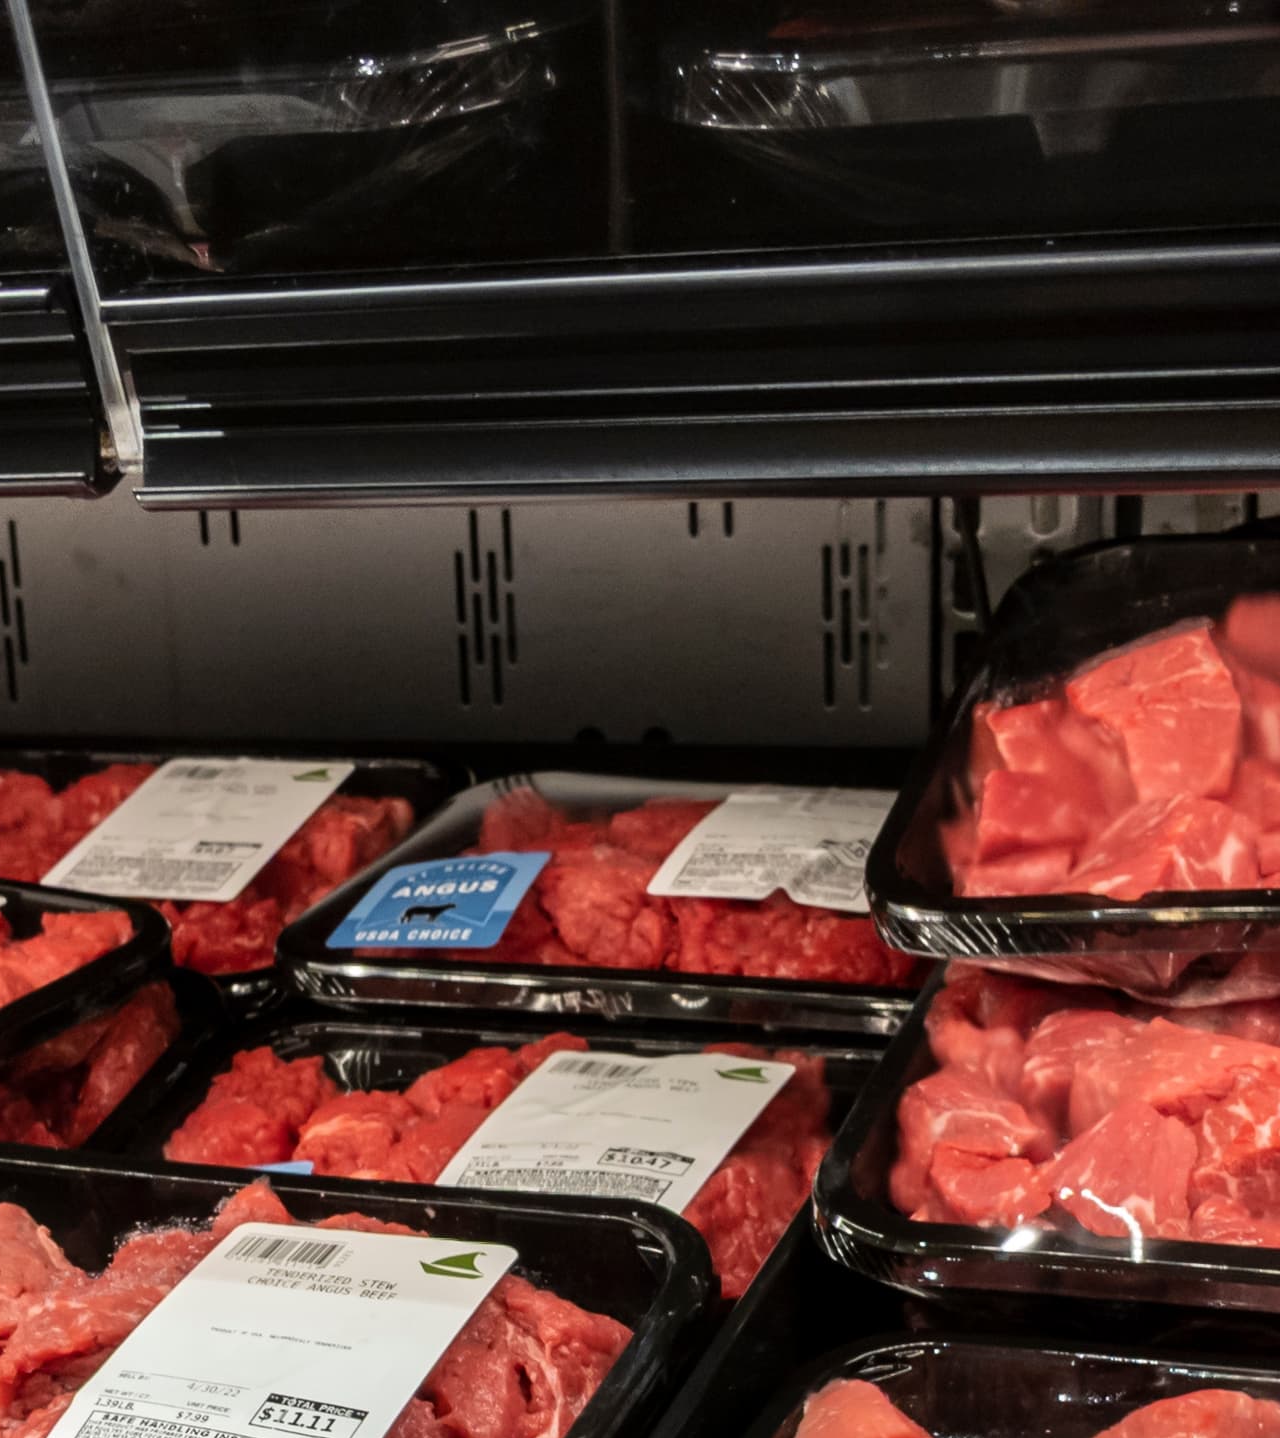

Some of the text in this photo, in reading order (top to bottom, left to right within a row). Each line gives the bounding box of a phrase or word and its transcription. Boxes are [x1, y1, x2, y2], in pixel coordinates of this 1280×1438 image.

[392, 880, 499, 898] ANGUS
[355, 928, 473, 941] USDA CHOICE
[247, 1275, 398, 1301] CHOICE ANGUS BEEF
[267, 1267, 398, 1291] TENDERIZED STEW
[186, 1381, 241, 1398] 4/30/22
[176, 1410, 210, 1423] $7.99
[280, 1396, 355, 1418] TOTAL PRICE
[102, 1414, 138, 1425] SAFE
[139, 1419, 211, 1438] HANDLING
[258, 1406, 337, 1433] $11.11
